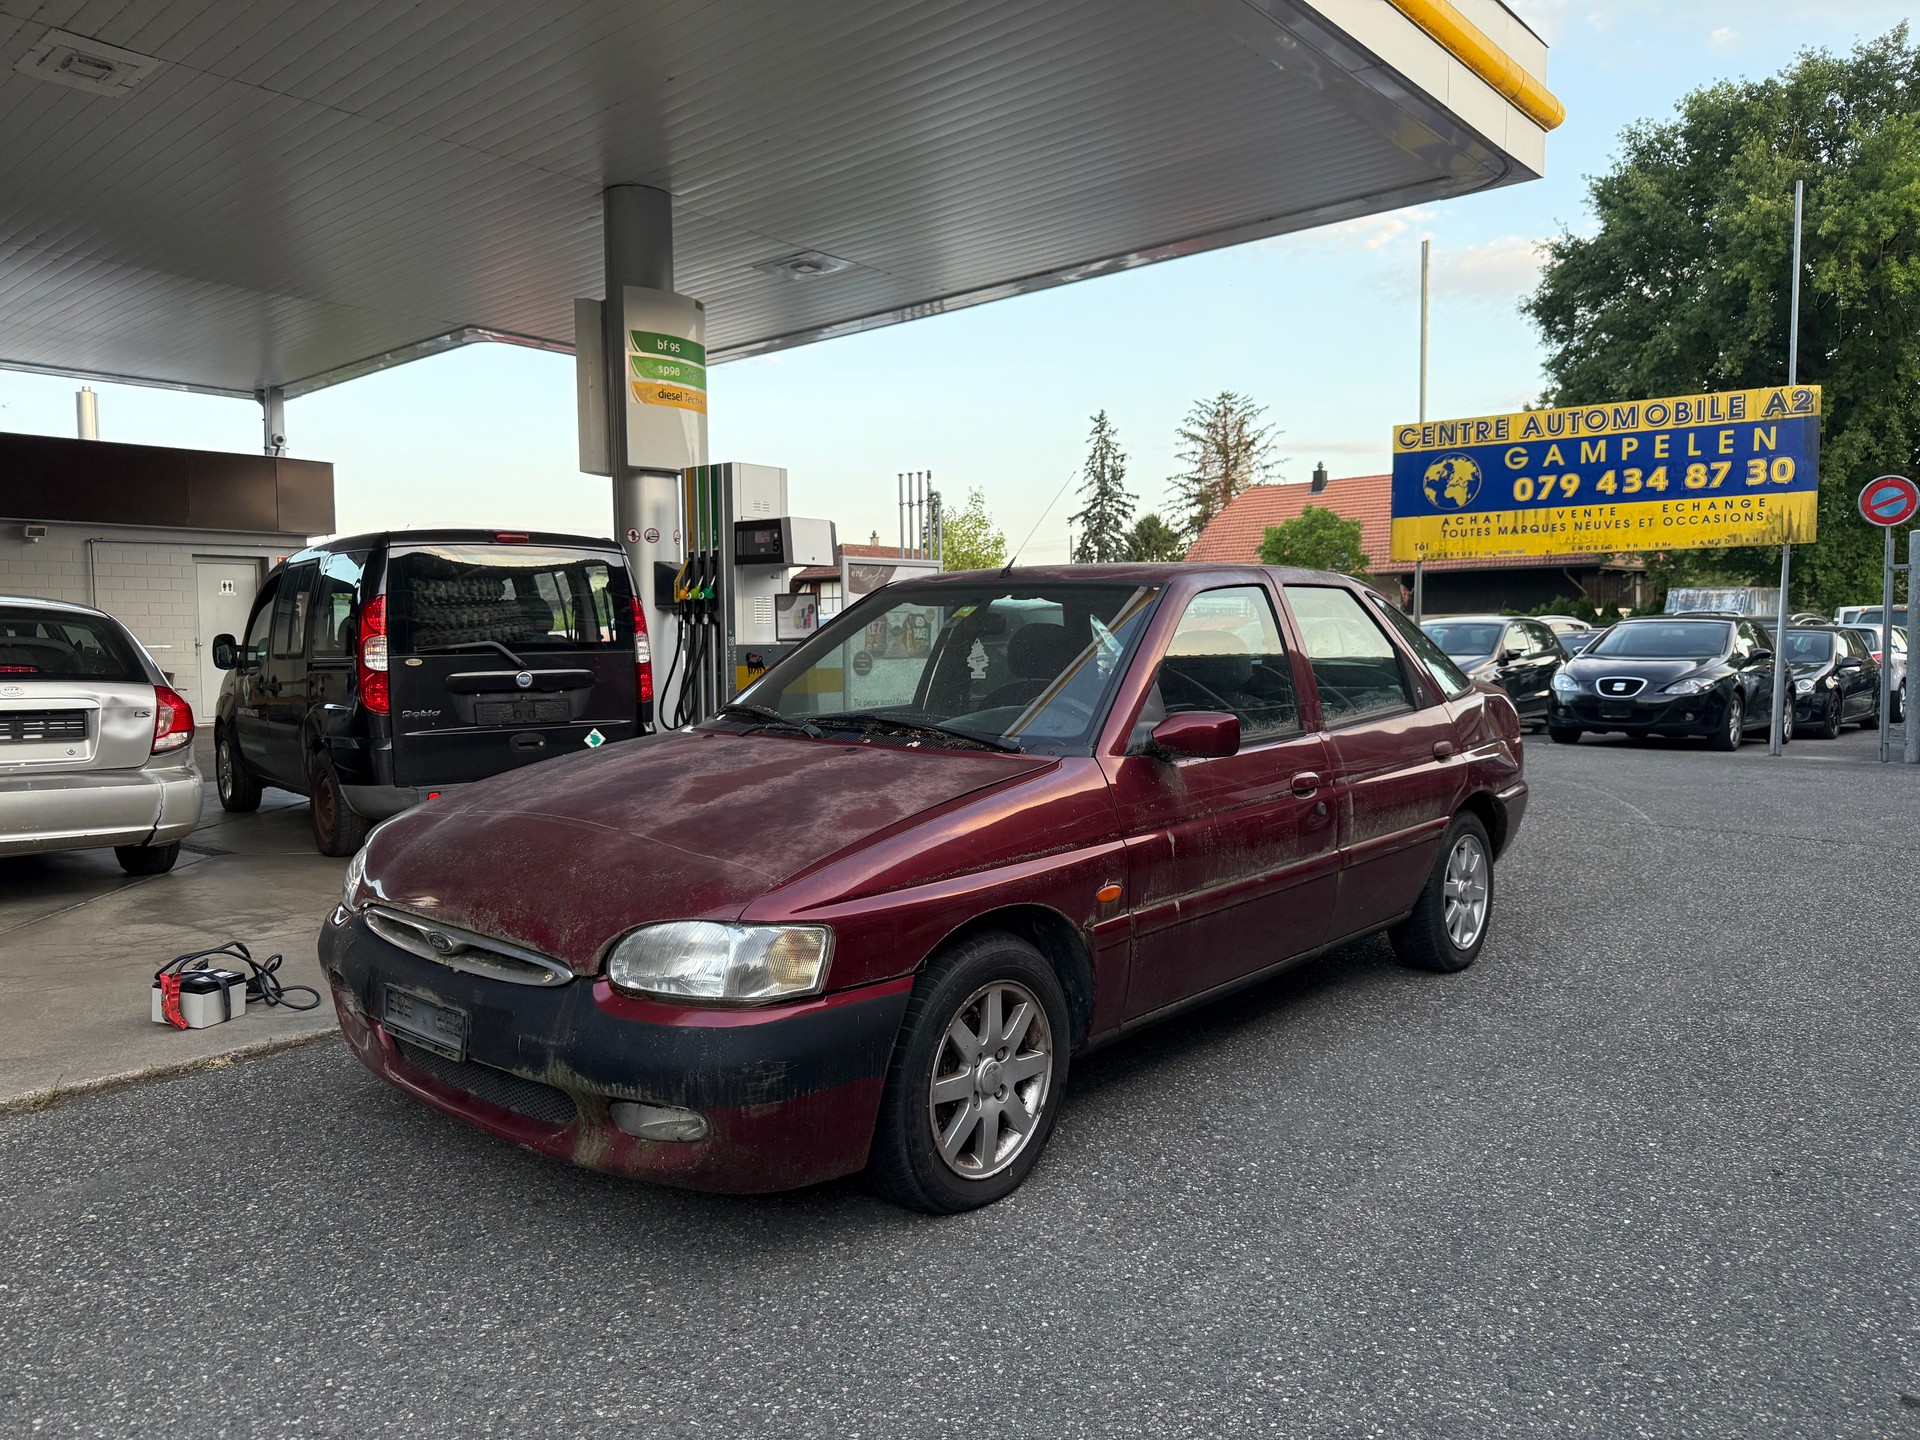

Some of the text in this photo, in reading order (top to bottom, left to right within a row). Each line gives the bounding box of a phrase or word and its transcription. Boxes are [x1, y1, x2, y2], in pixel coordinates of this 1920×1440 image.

[657, 339, 681, 353] bf 95
[658, 365, 681, 377] sp98
[658, 388, 683, 402] diesel
[1398, 387, 1815, 449] CENTRE AUTOMOBILE A2
[1504, 426, 1777, 470] GAMPELEN
[1513, 456, 1796, 502] 079 434 87 30
[1442, 497, 1766, 527] ACHAT VENTE ECHANGE
[1441, 511, 1765, 539] TOUTES MARQUES NEUVES ET OCCASIONS
[772, 539, 780, 552] 5
[1414, 542, 1429, 551] Tél
[134, 710, 151, 718] LS
